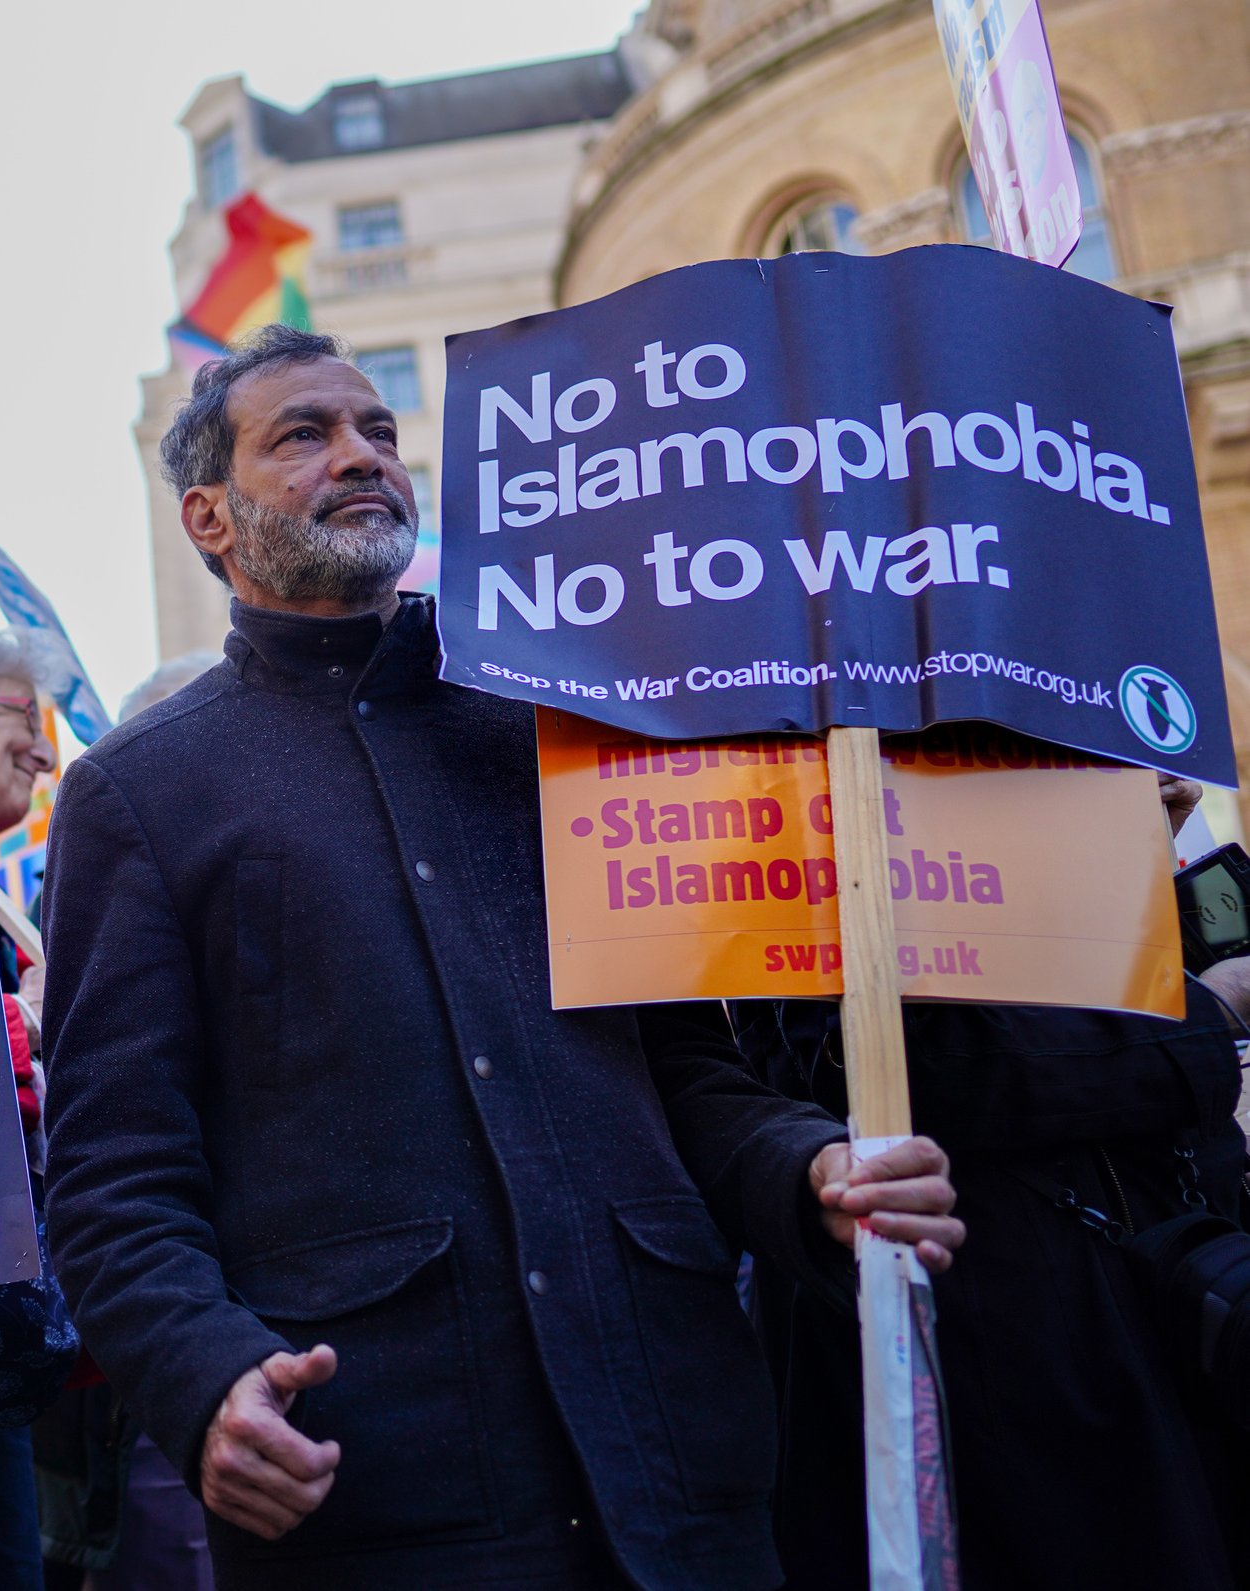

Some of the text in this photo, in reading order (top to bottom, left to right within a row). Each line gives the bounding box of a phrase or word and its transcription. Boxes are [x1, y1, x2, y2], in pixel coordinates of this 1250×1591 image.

[478, 340, 747, 453] No to
[478, 402, 1171, 535] Islamophobia.
[477, 523, 1010, 631] No to war.
[480, 650, 1114, 709] Stop the War Coalition. www.stopwar.org.uk
[600, 788, 905, 849] Stamp ot
[607, 849, 1005, 910] Islamopobia
[764, 941, 984, 976] swpg.uk
